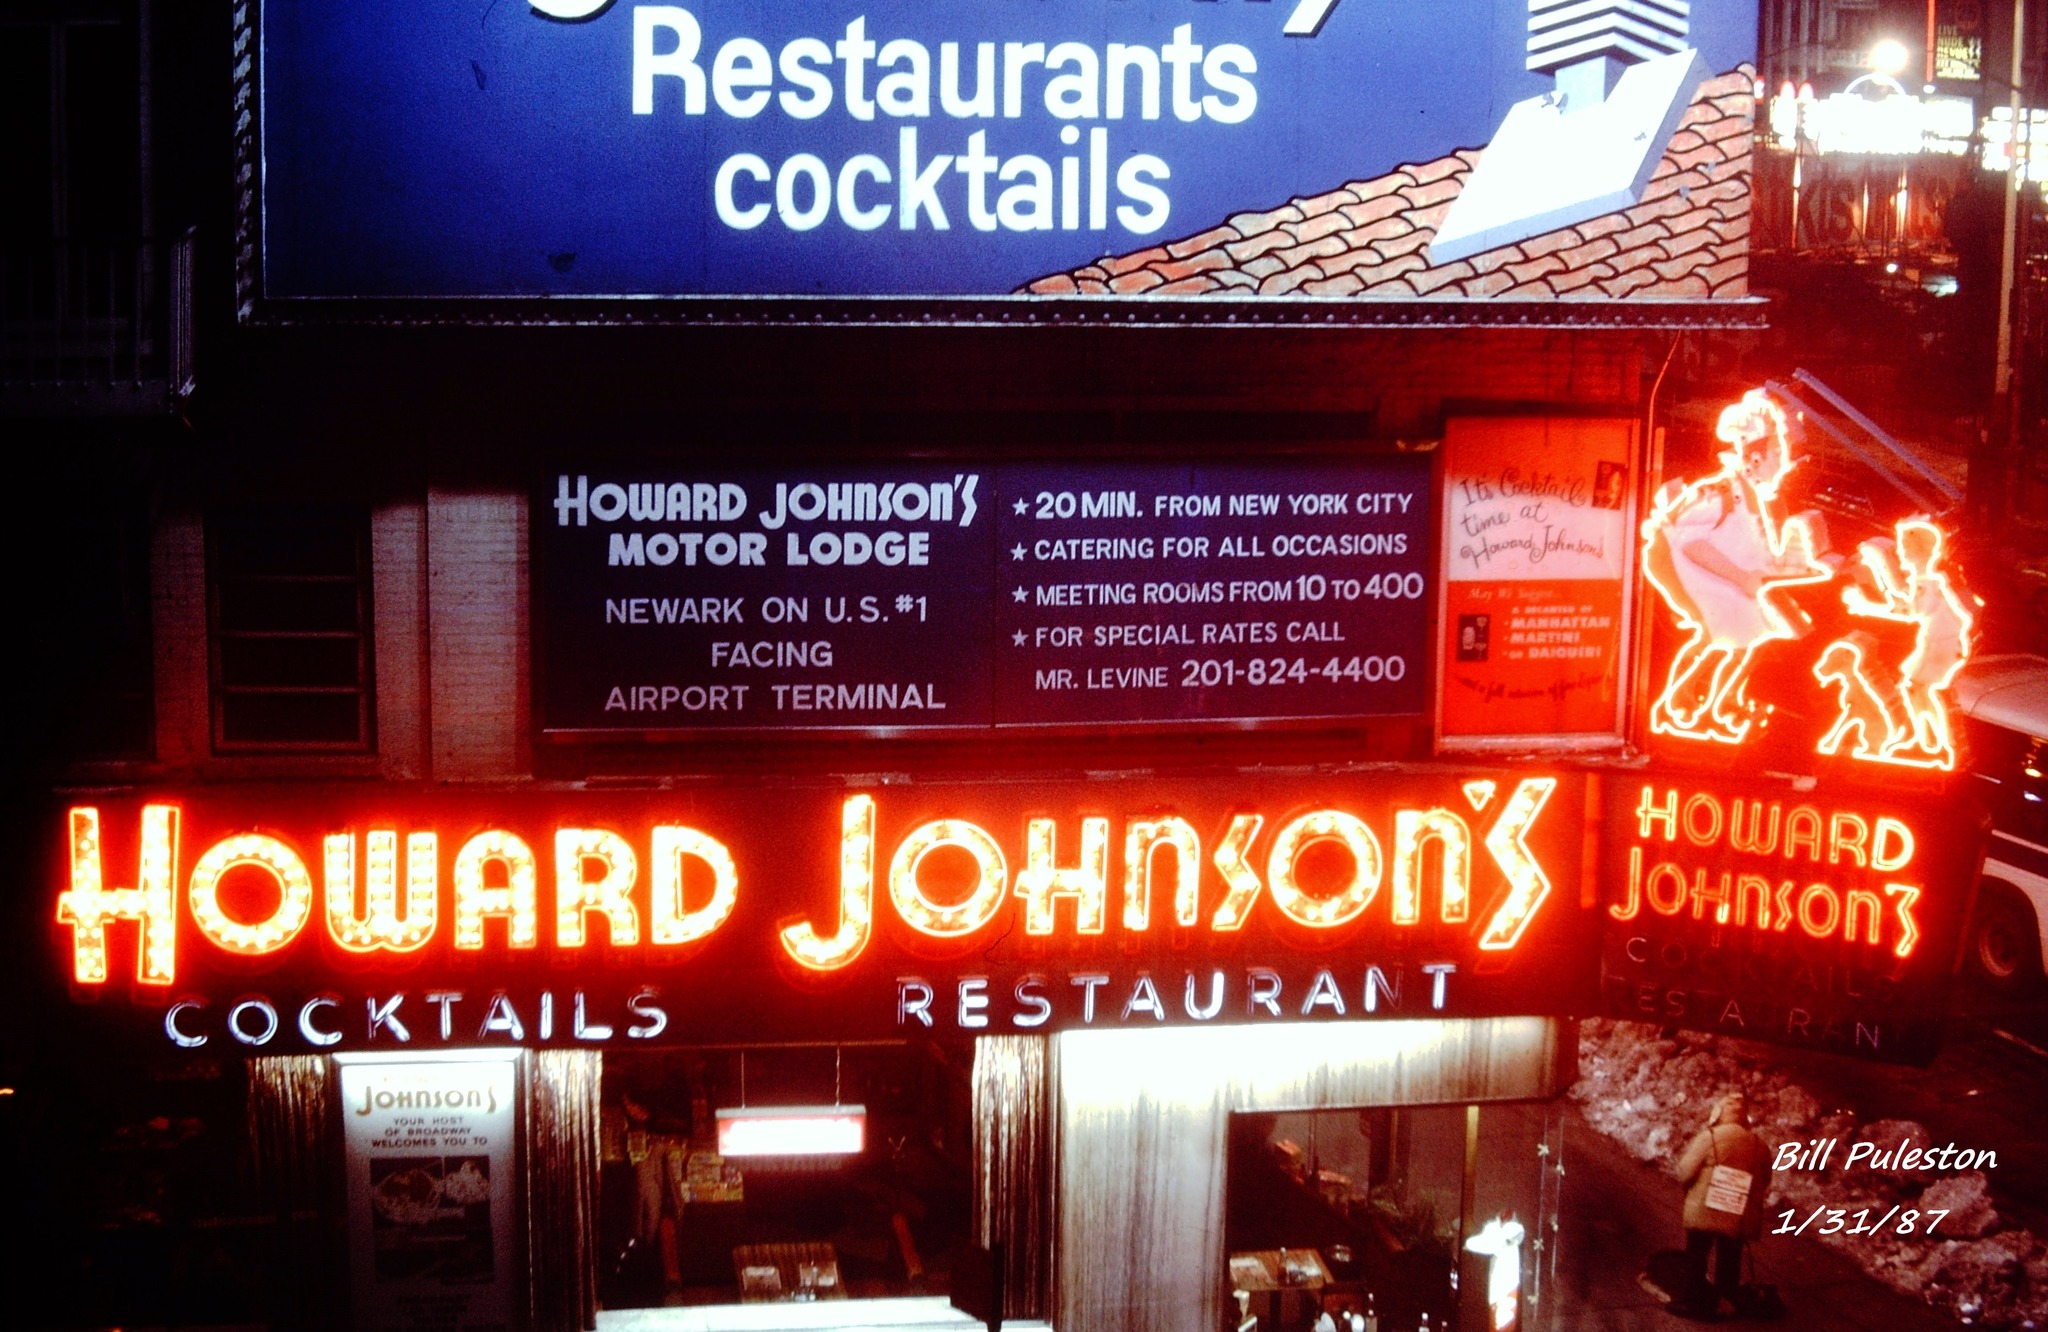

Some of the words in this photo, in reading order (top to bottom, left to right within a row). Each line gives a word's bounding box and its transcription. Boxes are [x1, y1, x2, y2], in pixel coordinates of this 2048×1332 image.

[631, 5, 1259, 123] Restaurants
[714, 126, 1172, 234] cocktails
[554, 474, 747, 526] HOWARD
[1499, 467, 1587, 507] Cocktail
[1036, 491, 1076, 519] 20
[1082, 491, 1143, 518] MIN.
[1155, 495, 1221, 517] FROM
[1229, 494, 1280, 516] NEW
[1288, 494, 1348, 515] YORK
[1356, 493, 1413, 514] CITY
[1460, 512, 1510, 536] time
[1520, 502, 1549, 523] at
[608, 531, 766, 566] MOTOR
[787, 531, 930, 566] LODGE
[1034, 537, 1154, 560] CATERING
[1163, 536, 1209, 558] FOR
[1218, 535, 1265, 557] ALL
[1272, 533, 1408, 557] OCCASIONS
[1460, 537, 1536, 568] Howard
[1036, 583, 1136, 606] MEETING
[1143, 582, 1224, 604] ROOMS
[1229, 580, 1292, 603] FROM
[1296, 574, 1326, 601] 10
[1332, 579, 1361, 600] TO
[1364, 572, 1424, 600] 400
[606, 597, 744, 624] NEWARK
[761, 596, 808, 623] ON
[1510, 616, 1610, 629] MANHATTAN
[1036, 627, 1083, 648] FOR
[1094, 624, 1194, 646] SPECIAL
[1202, 622, 1277, 645] RATES
[1286, 621, 1345, 642] CALL
[1510, 632, 1580, 644] MARTINI
[711, 641, 833, 667] FACING
[1528, 646, 1602, 660] DAIQUIRI
[1036, 669, 1079, 690] MR.
[1088, 667, 1168, 689] LEVINE
[1181, 656, 1406, 687] 201-824-4400
[605, 685, 749, 711] AIRPORT
[771, 683, 946, 709] TERMINAL
[1635, 786, 1915, 873] HOWARD
[56, 803, 739, 986] HOWARD
[896, 963, 1456, 1028] RESTAURANT
[164, 989, 669, 1047] COCKTAILS
[385, 1127, 399, 1137] OF
[407, 1127, 472, 1137] BROADWAY
[394, 1117, 425, 1126] YOUR
[433, 1116, 464, 1125] HOST
[371, 1138, 437, 1148] WELCOMES
[443, 1137, 467, 1147] YOU
[473, 1136, 488, 1145] TO
